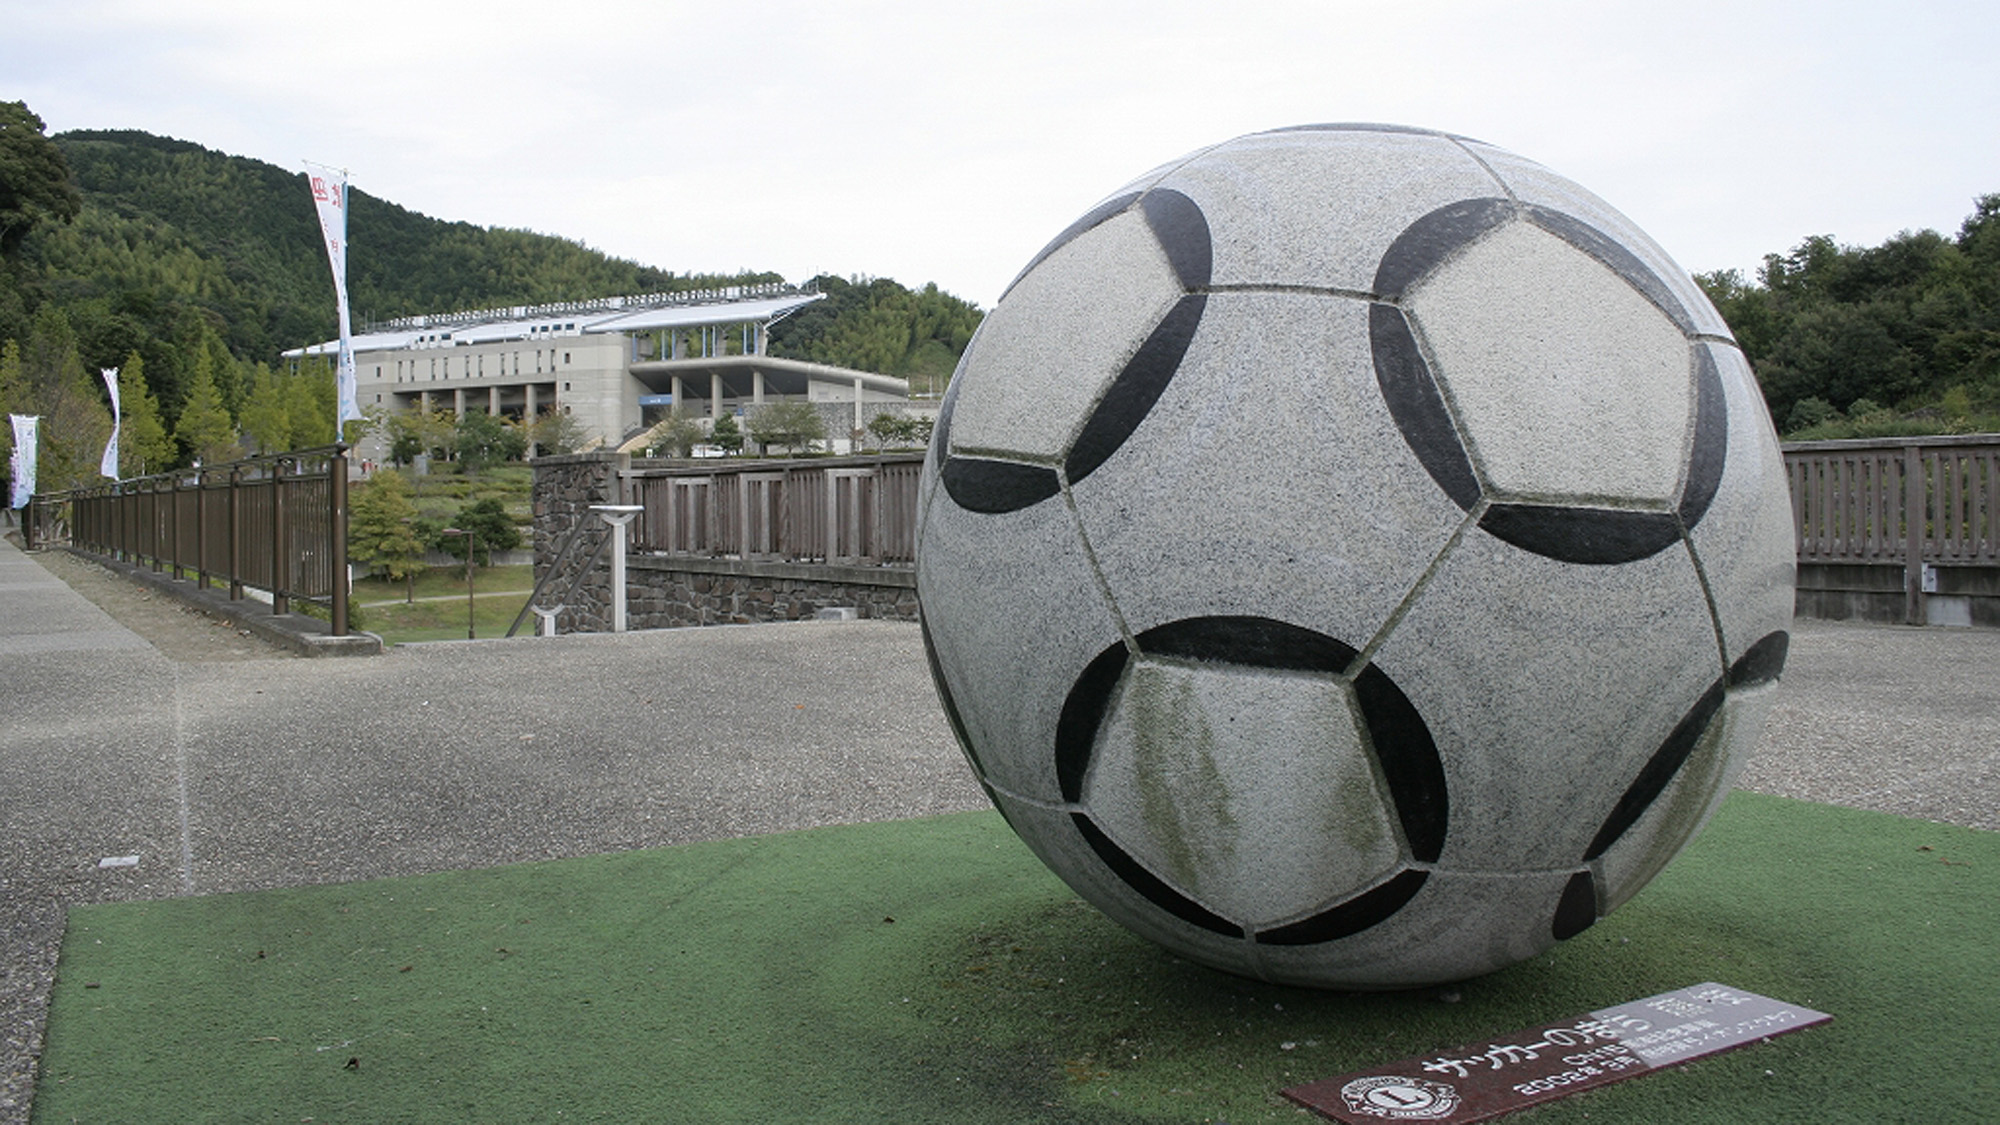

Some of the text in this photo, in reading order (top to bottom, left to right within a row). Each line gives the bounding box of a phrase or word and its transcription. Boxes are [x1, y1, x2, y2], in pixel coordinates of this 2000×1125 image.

[1421, 1013, 1653, 1079] サッカーのまち
[1376, 1089, 1424, 1106] L
